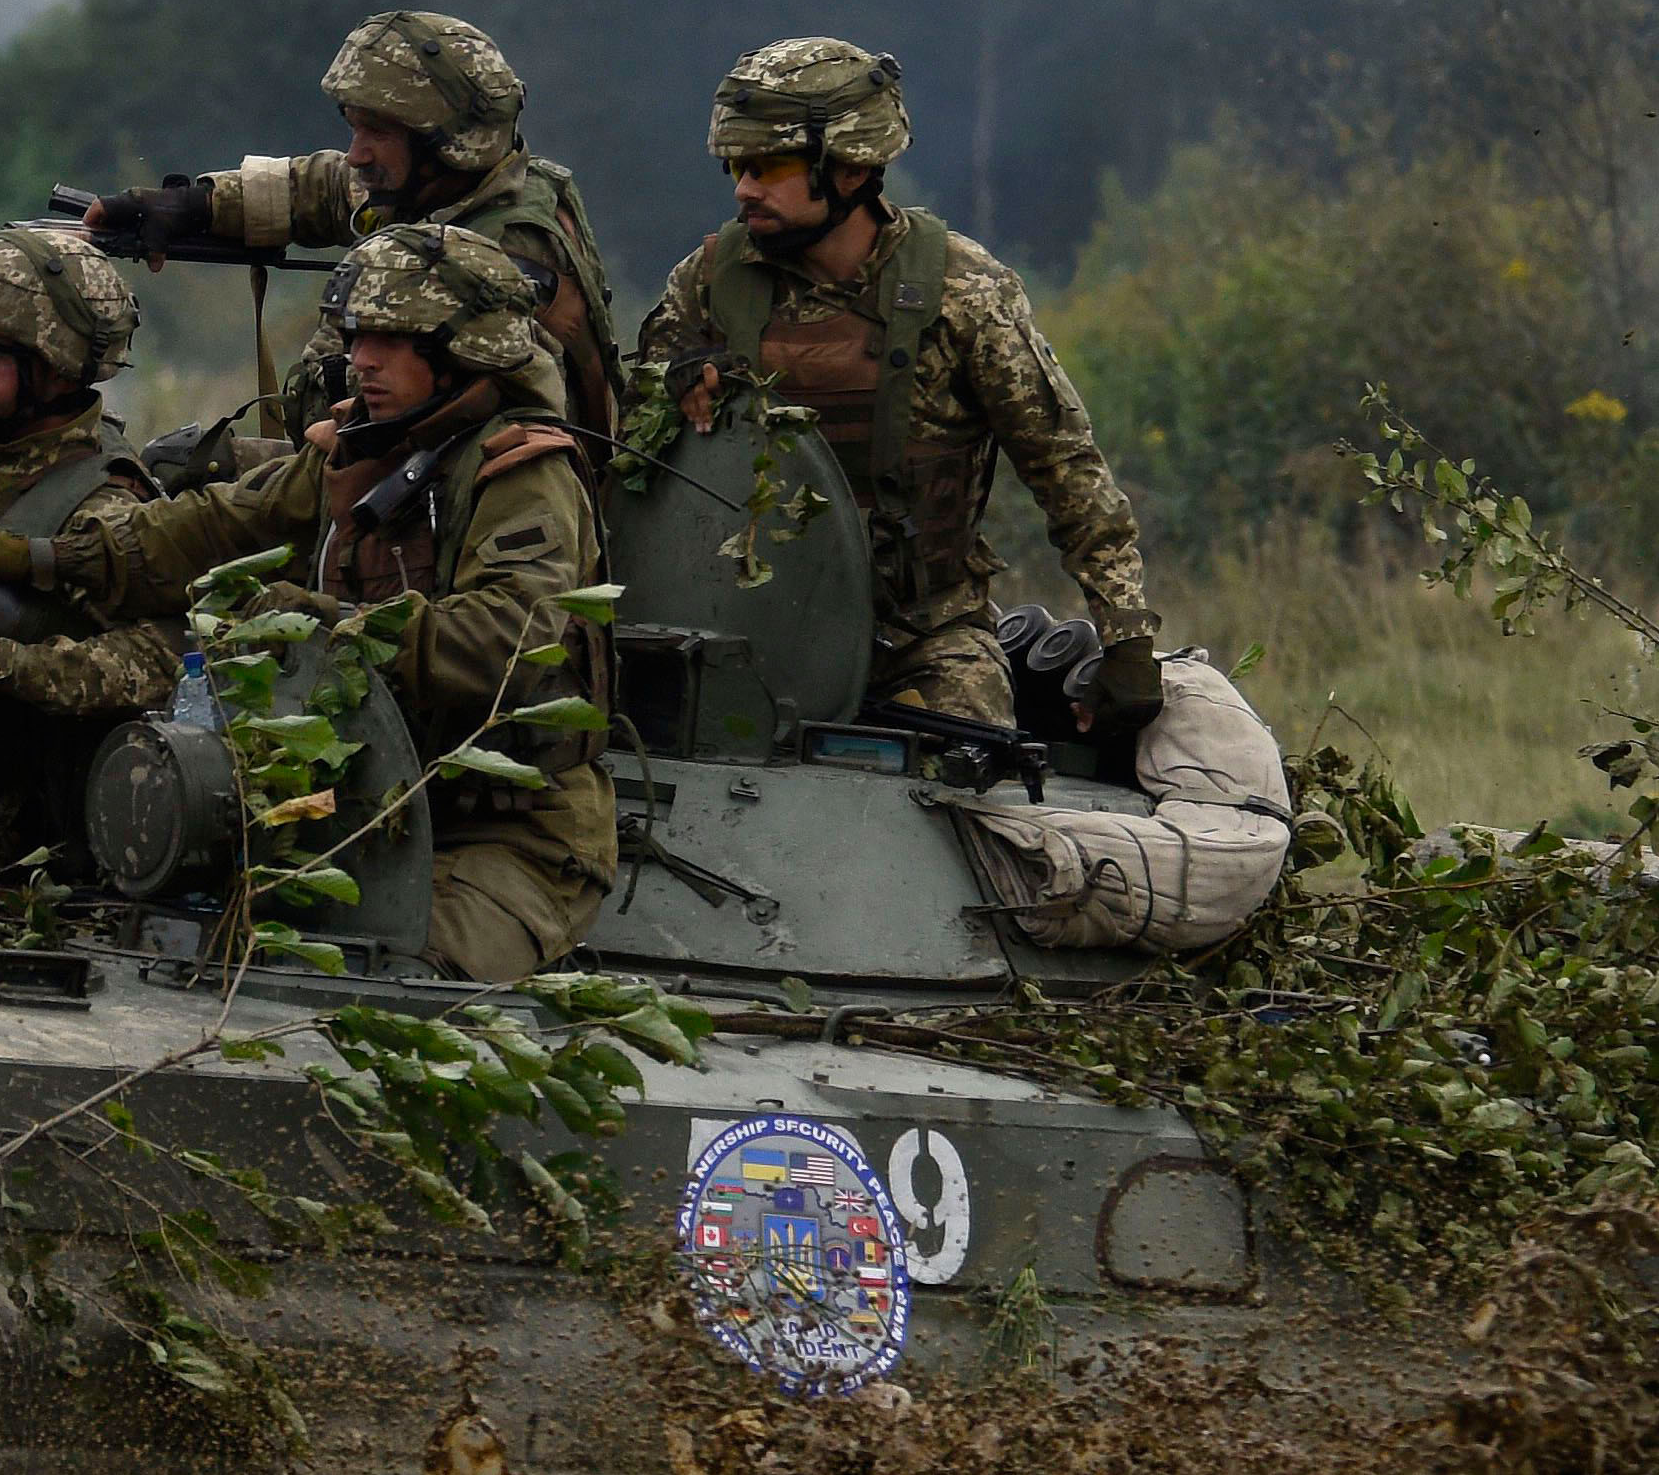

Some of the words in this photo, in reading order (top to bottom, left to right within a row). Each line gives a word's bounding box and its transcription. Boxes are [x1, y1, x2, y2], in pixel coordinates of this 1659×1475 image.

[773, 1119, 869, 1172] SECURITY
[779, 1321, 838, 1339] AID
[771, 1338, 859, 1360] IDENT
